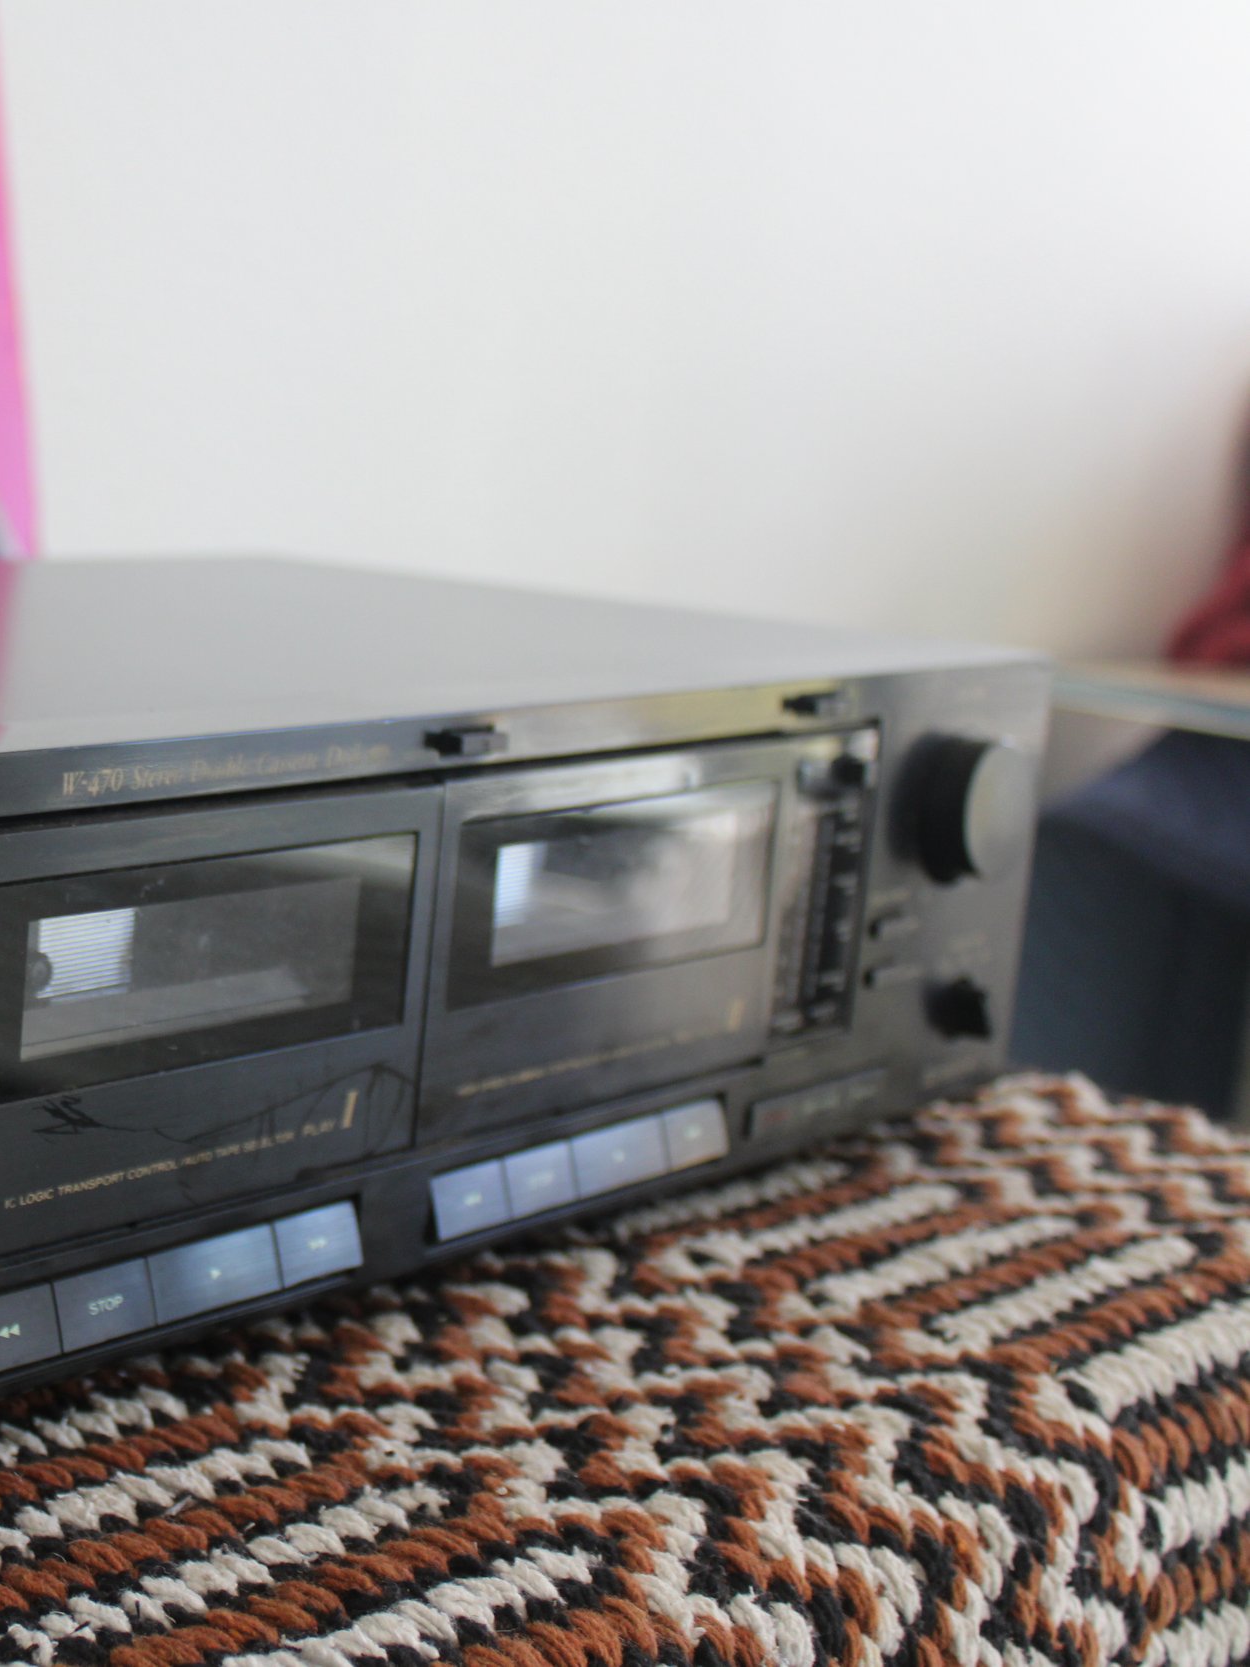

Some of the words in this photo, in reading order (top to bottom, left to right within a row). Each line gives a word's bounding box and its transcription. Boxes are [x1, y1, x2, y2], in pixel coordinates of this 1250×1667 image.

[62, 768, 125, 796] W-470
[19, 1189, 55, 1206] LOGIC
[58, 1171, 126, 1196] TRANSPORT
[89, 1295, 124, 1316] STOP
